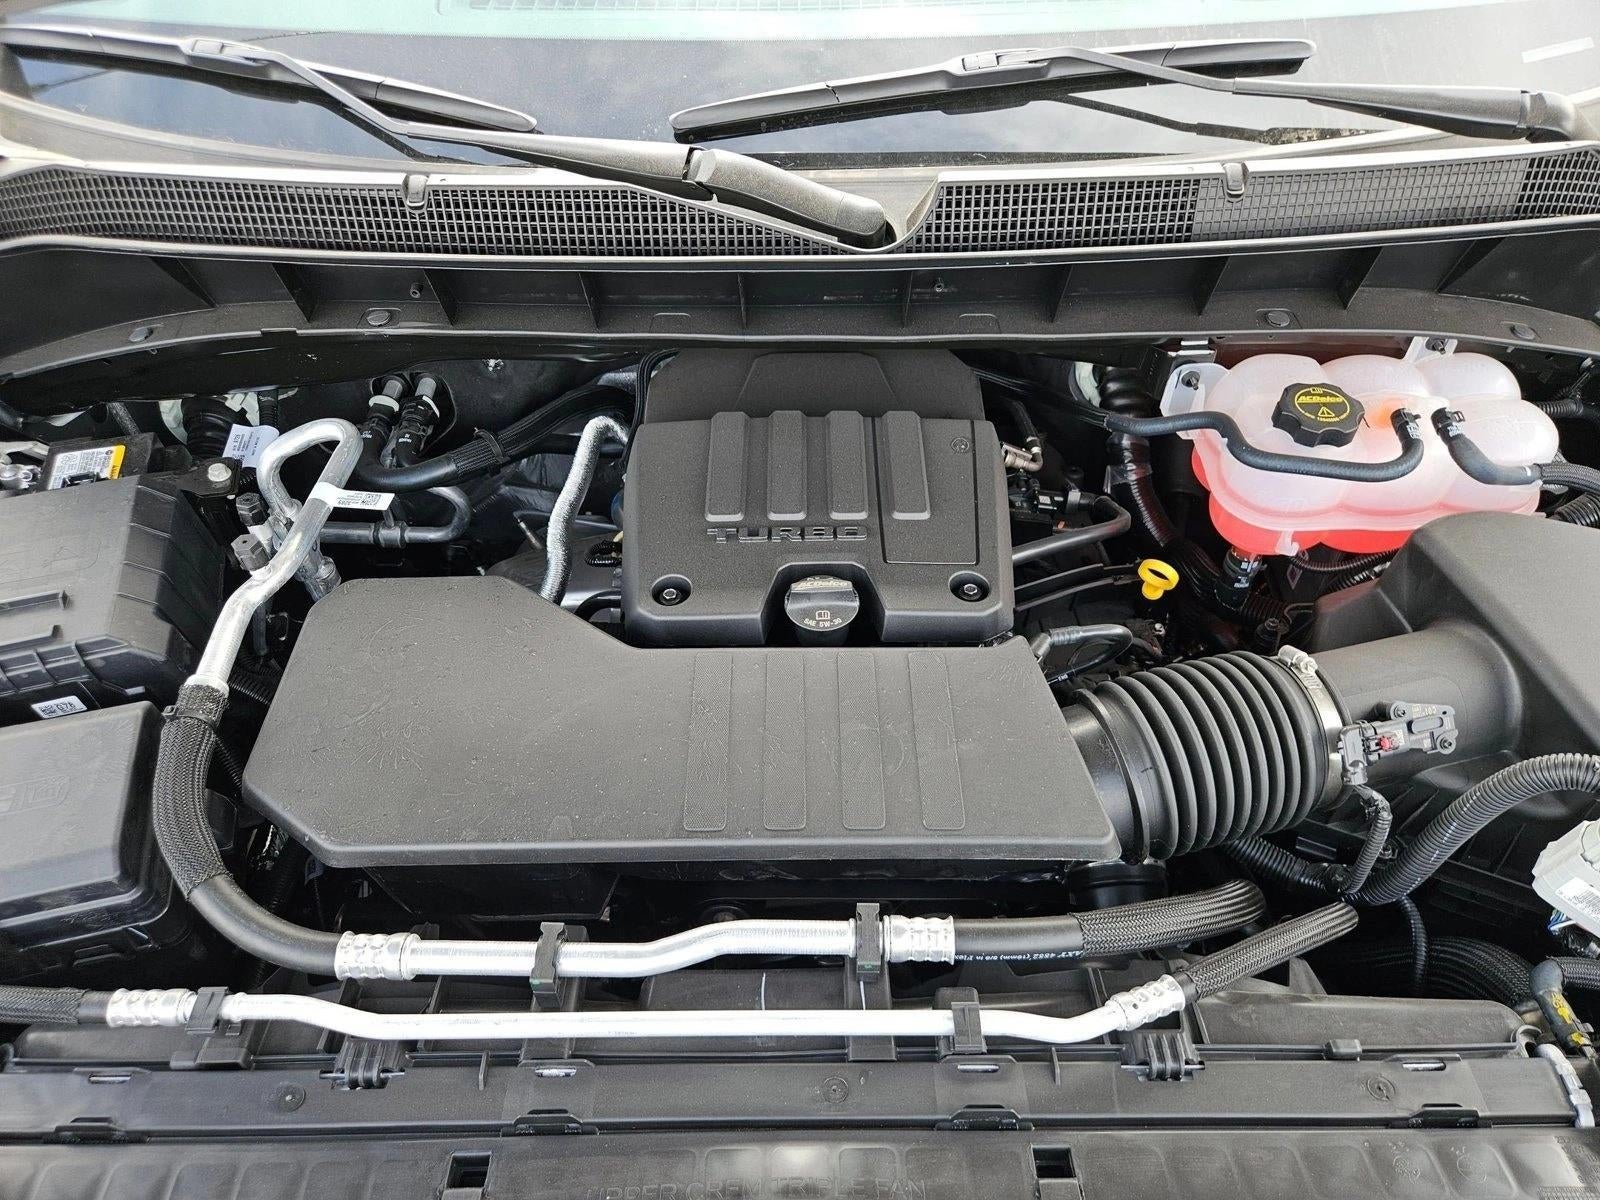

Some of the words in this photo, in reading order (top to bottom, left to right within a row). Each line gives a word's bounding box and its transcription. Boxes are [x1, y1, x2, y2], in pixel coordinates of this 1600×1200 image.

[706, 526, 868, 544] TURBO
[803, 618, 817, 628] SAE
[819, 617, 843, 628] 5W-30
[874, 1178, 926, 1200] FAN
